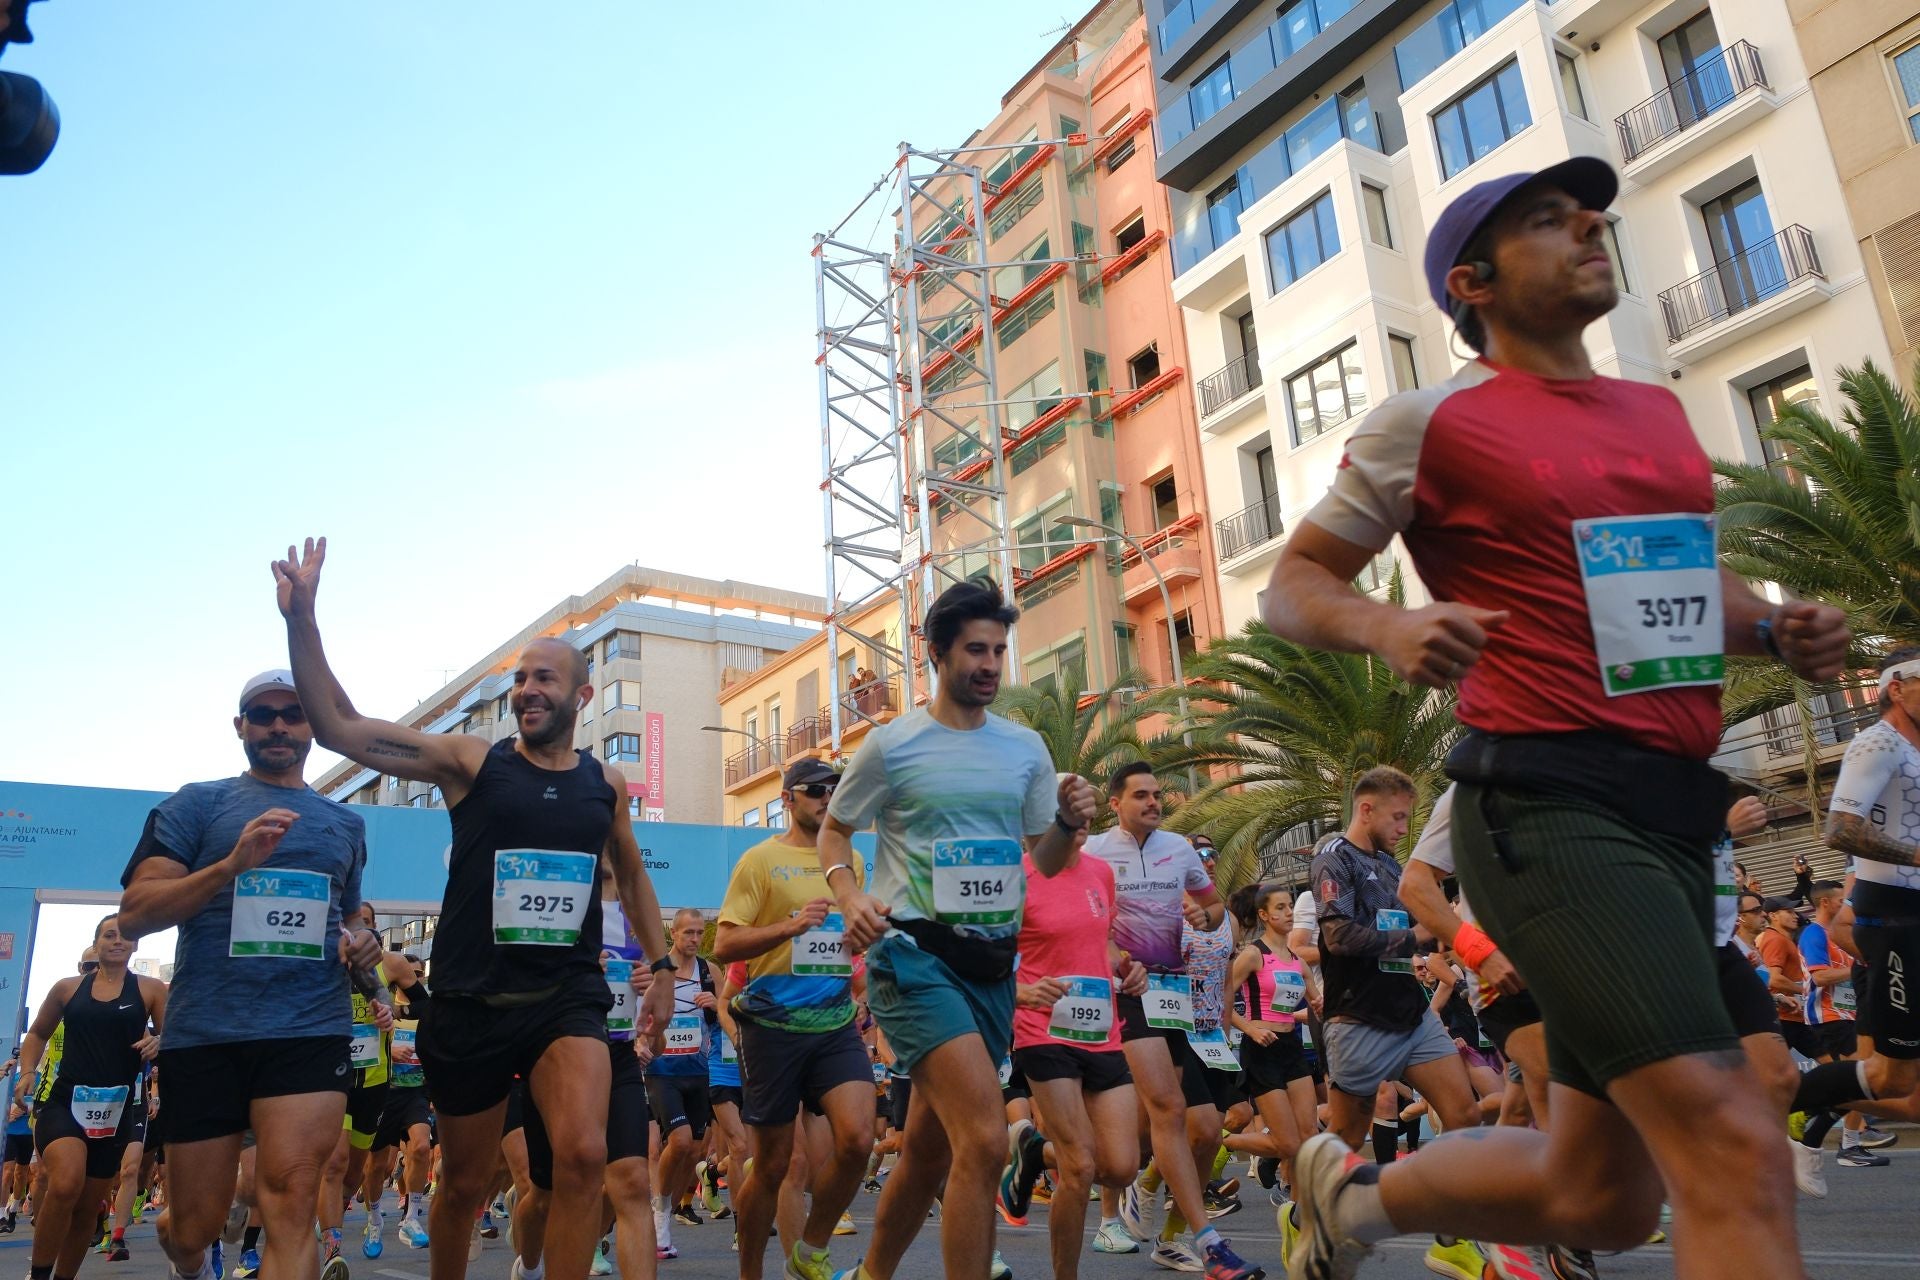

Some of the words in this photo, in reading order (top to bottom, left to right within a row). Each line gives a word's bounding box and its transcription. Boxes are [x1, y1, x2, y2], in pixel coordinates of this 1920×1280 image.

[1638, 595, 1706, 628] 3977
[649, 719, 660, 799] Rehabilitación
[14, 826, 79, 836] AJUNTAMENT
[12, 835, 37, 843] POLA
[960, 880, 1004, 897] 3164
[519, 894, 574, 913] 2975
[266, 910, 306, 928] 622
[808, 942, 843, 954] 2047
[1286, 990, 1299, 1000] 343
[1160, 999, 1181, 1011] 260
[1071, 1007, 1102, 1021] 1992
[669, 1033, 693, 1042] 4349
[1205, 1048, 1222, 1058] 259
